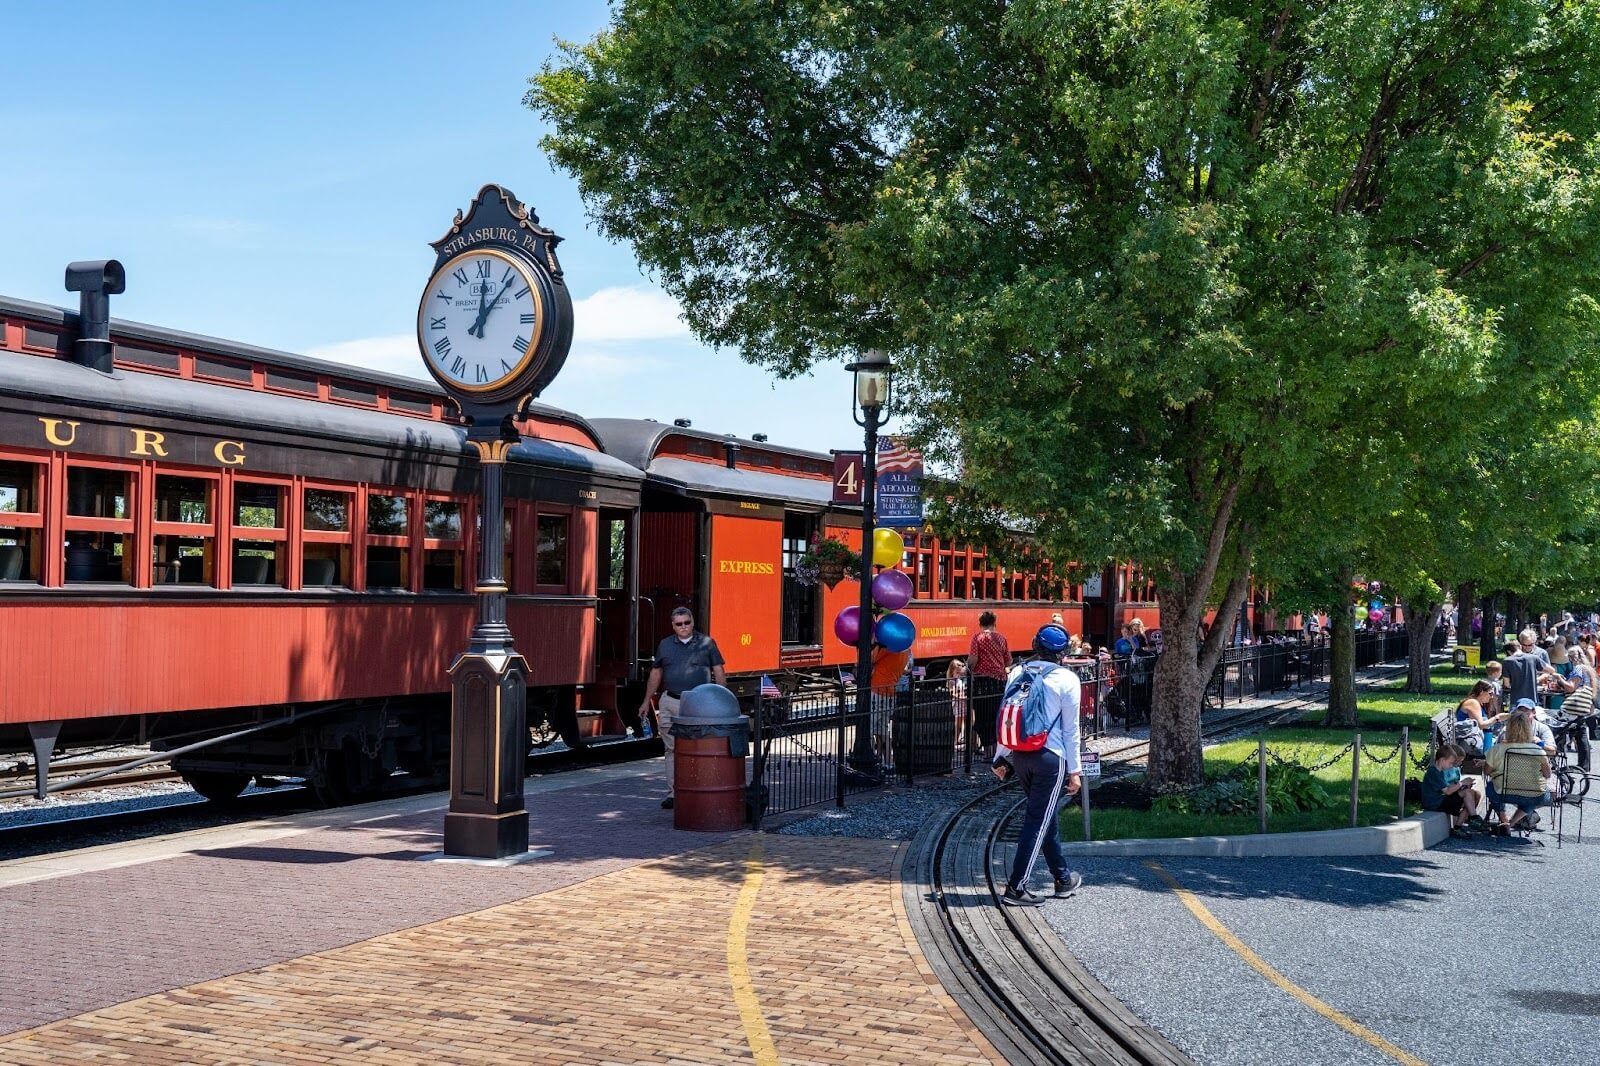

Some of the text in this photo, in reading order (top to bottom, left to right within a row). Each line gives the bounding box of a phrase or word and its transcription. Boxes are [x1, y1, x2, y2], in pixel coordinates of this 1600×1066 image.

[444, 227, 538, 257] STRASBURG, PA
[476, 259, 491, 278] XII
[453, 267, 469, 288] XI
[437, 289, 452, 306] X
[514, 286, 530, 300] II
[455, 299, 478, 307] BRENT
[430, 316, 446, 330] IX
[520, 313, 535, 325] III
[434, 336, 452, 361] VIII
[450, 355, 465, 378] VII
[476, 363, 488, 382] VI
[500, 358, 512, 375] V
[837, 461, 858, 495] 4
[890, 474, 911, 482] ALL
[879, 484, 920, 493] ABOARD
[740, 633, 752, 646] 60
